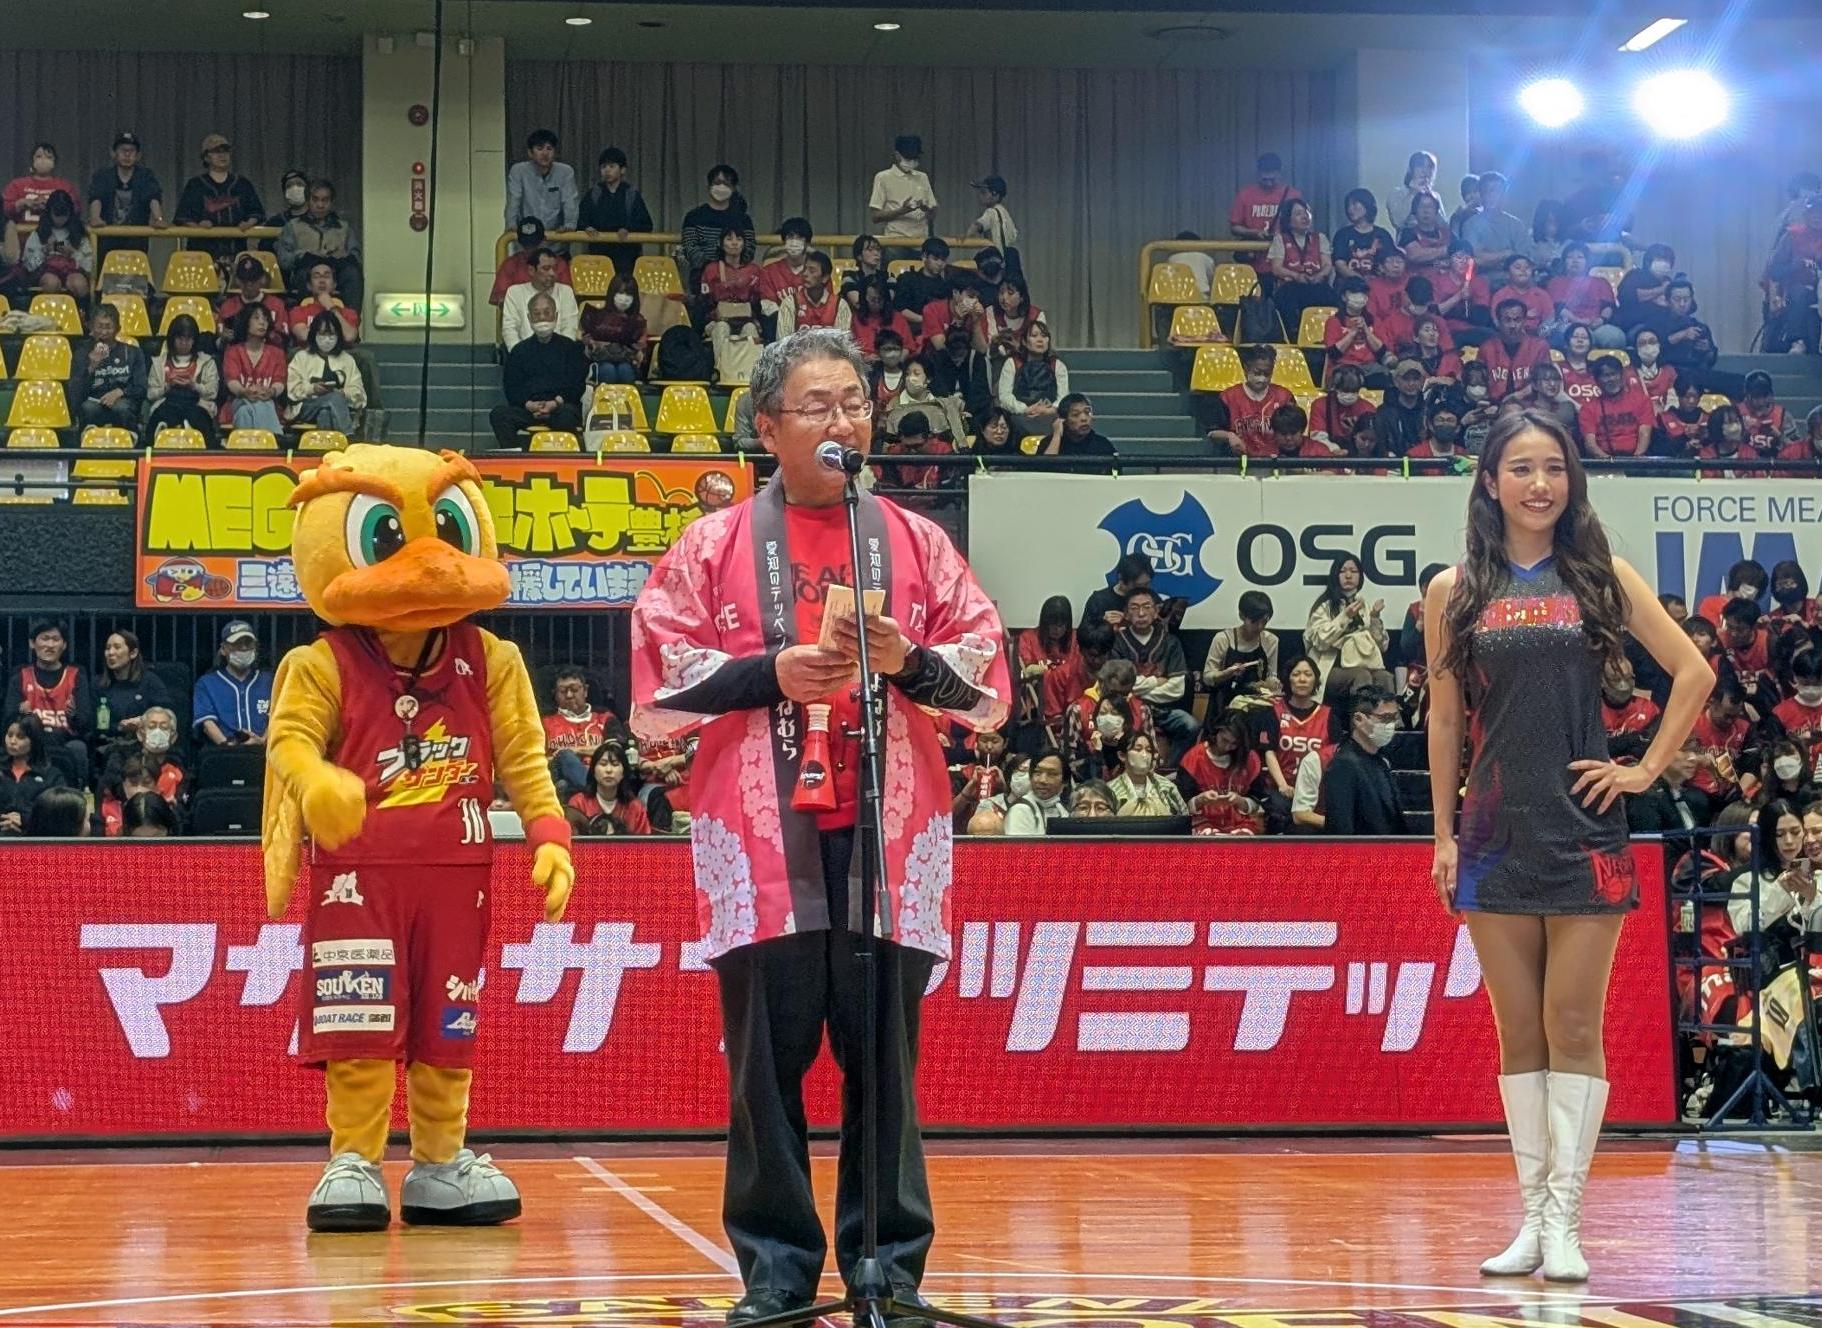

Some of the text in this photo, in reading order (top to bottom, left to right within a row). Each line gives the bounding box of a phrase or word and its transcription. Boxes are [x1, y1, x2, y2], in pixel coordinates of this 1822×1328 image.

[1653, 496, 1756, 523] FORCE
[1236, 524, 1416, 587] OSG
[1279, 735, 1322, 752] OSG
[316, 970, 384, 997] SOUKEN
[339, 1013, 365, 1024] RACE
